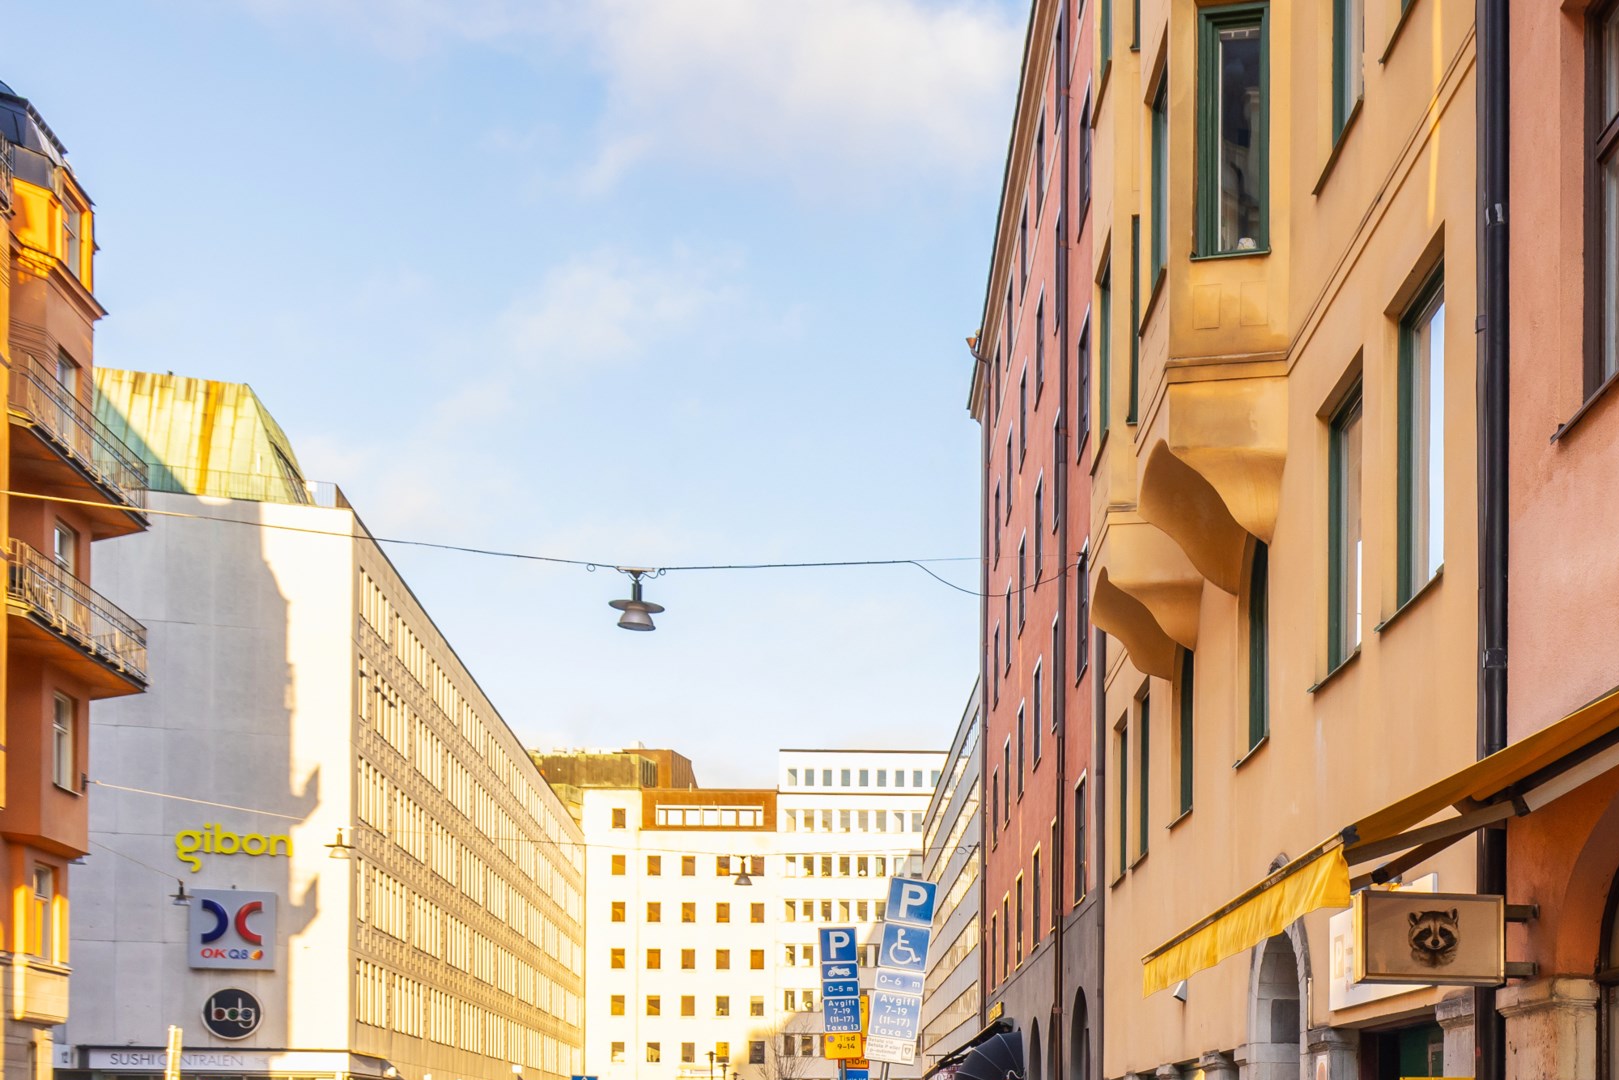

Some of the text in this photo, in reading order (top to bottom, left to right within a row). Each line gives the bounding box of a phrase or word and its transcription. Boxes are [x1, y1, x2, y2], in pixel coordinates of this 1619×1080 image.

[174, 822, 294, 873] gibon
[899, 883, 928, 918] P
[828, 931, 850, 959] P
[880, 975, 921, 988] 0-6 m
[828, 1000, 855, 1008] Avgift
[880, 994, 915, 1007] Avgift
[210, 997, 256, 1029] bdg
[885, 1005, 908, 1016] 7-19
[830, 1015, 855, 1023] (11-17)
[879, 1014, 911, 1028] (11-17)
[874, 1025, 913, 1038] Taxa 3
[110, 1052, 155, 1066] SUSHI
[157, 1053, 244, 1067] CNTRALEN
